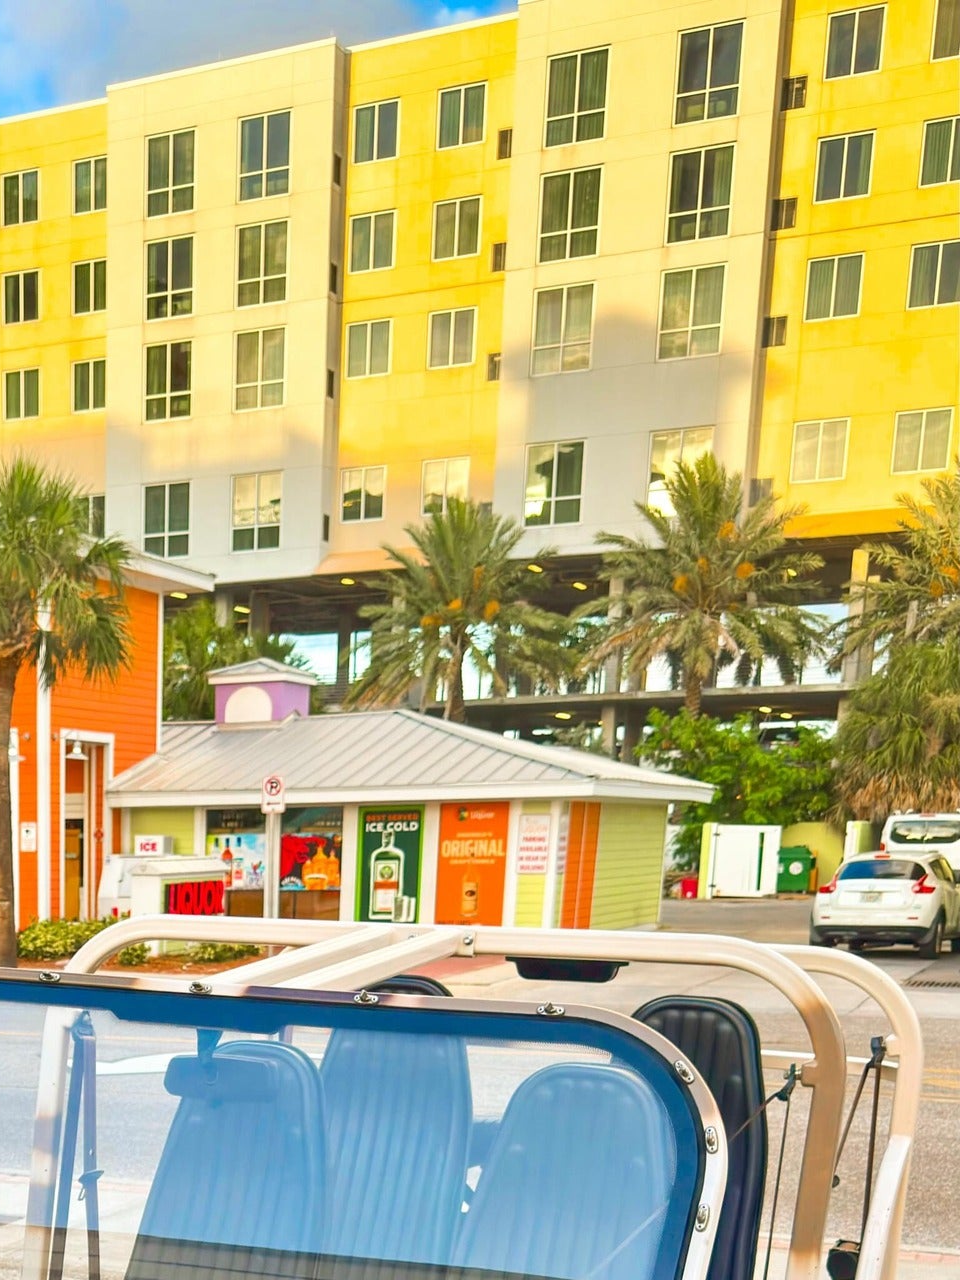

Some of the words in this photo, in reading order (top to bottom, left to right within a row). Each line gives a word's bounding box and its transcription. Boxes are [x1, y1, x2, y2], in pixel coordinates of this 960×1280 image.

[365, 822, 384, 832] ICE
[386, 821, 419, 832] COLD
[140, 842, 158, 852] ICE
[442, 839, 506, 858] ORIGINAL
[169, 880, 224, 915] LIQUOR
